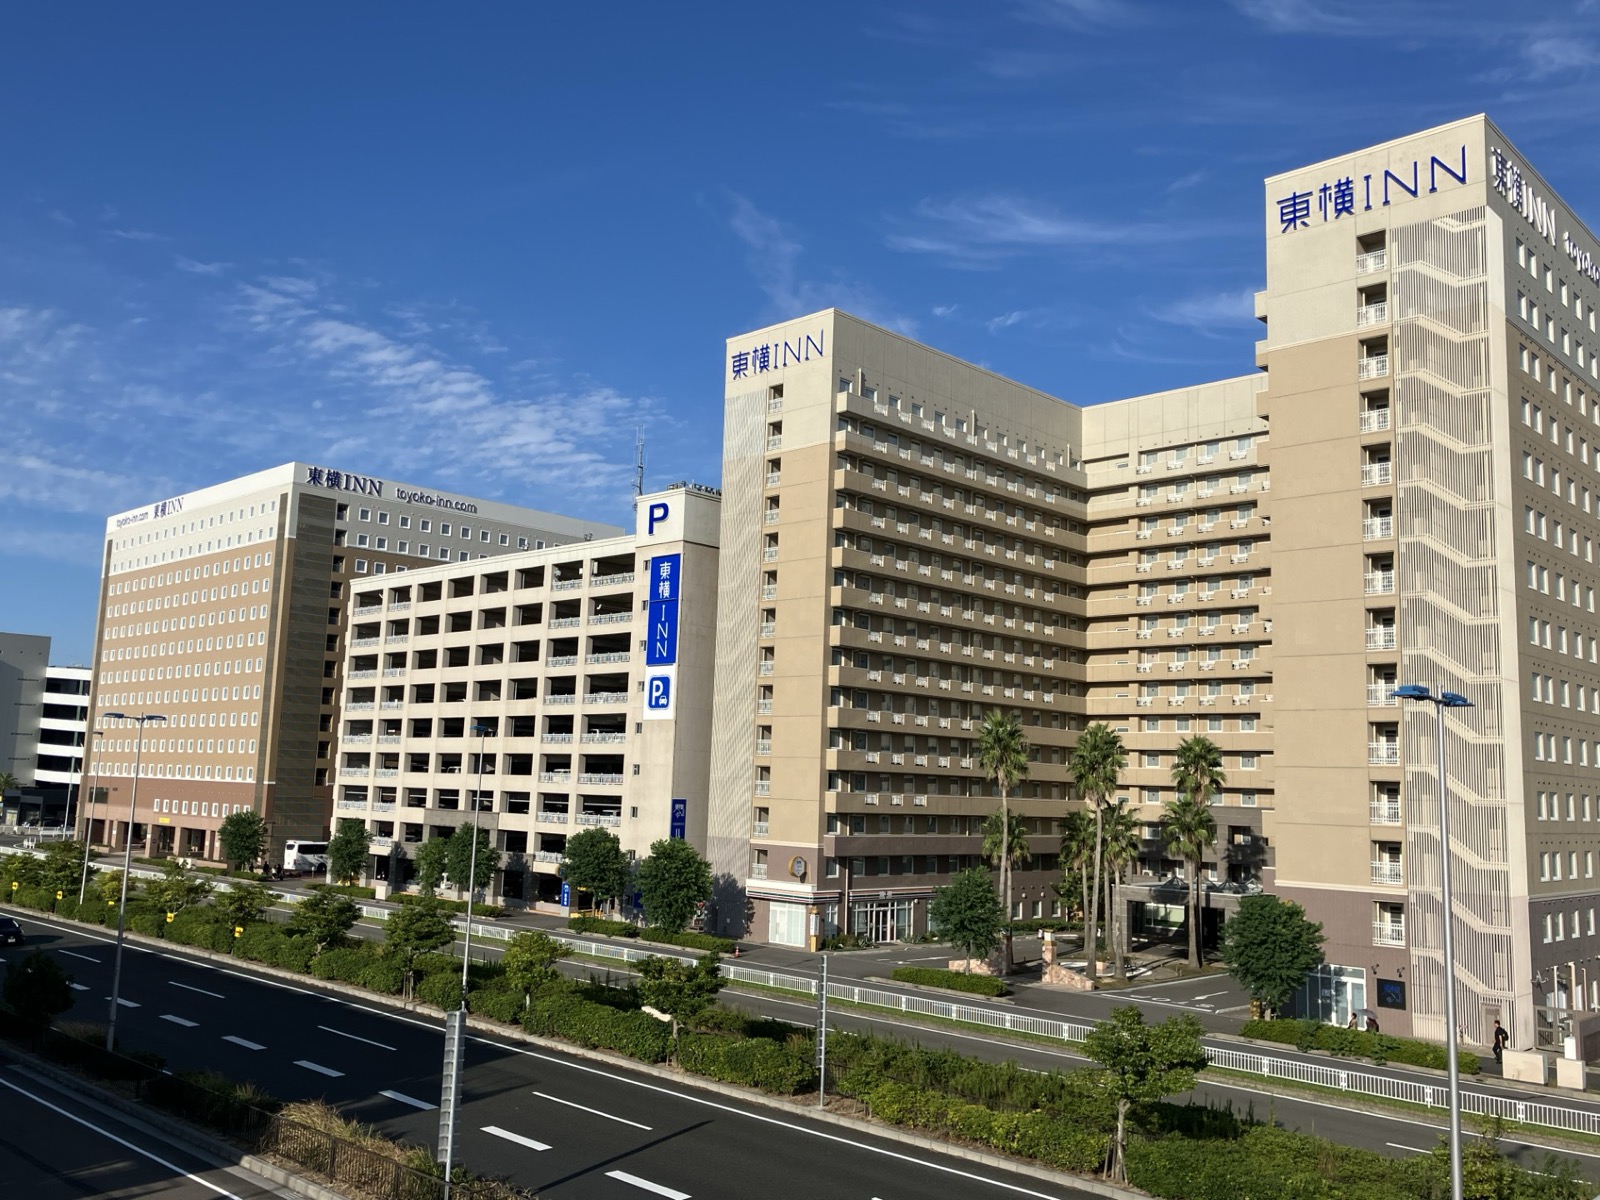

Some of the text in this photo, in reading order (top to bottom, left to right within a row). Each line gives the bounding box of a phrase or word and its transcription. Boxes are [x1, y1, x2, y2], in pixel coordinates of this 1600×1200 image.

[1276, 144, 1467, 234] 東横INN
[1490, 146, 1556, 246] 東横INN
[730, 329, 825, 381] 東横INN
[307, 466, 478, 514] 東横INN toyoko-inn.com
[648, 502, 669, 536] P
[655, 561, 672, 658] 東横INN
